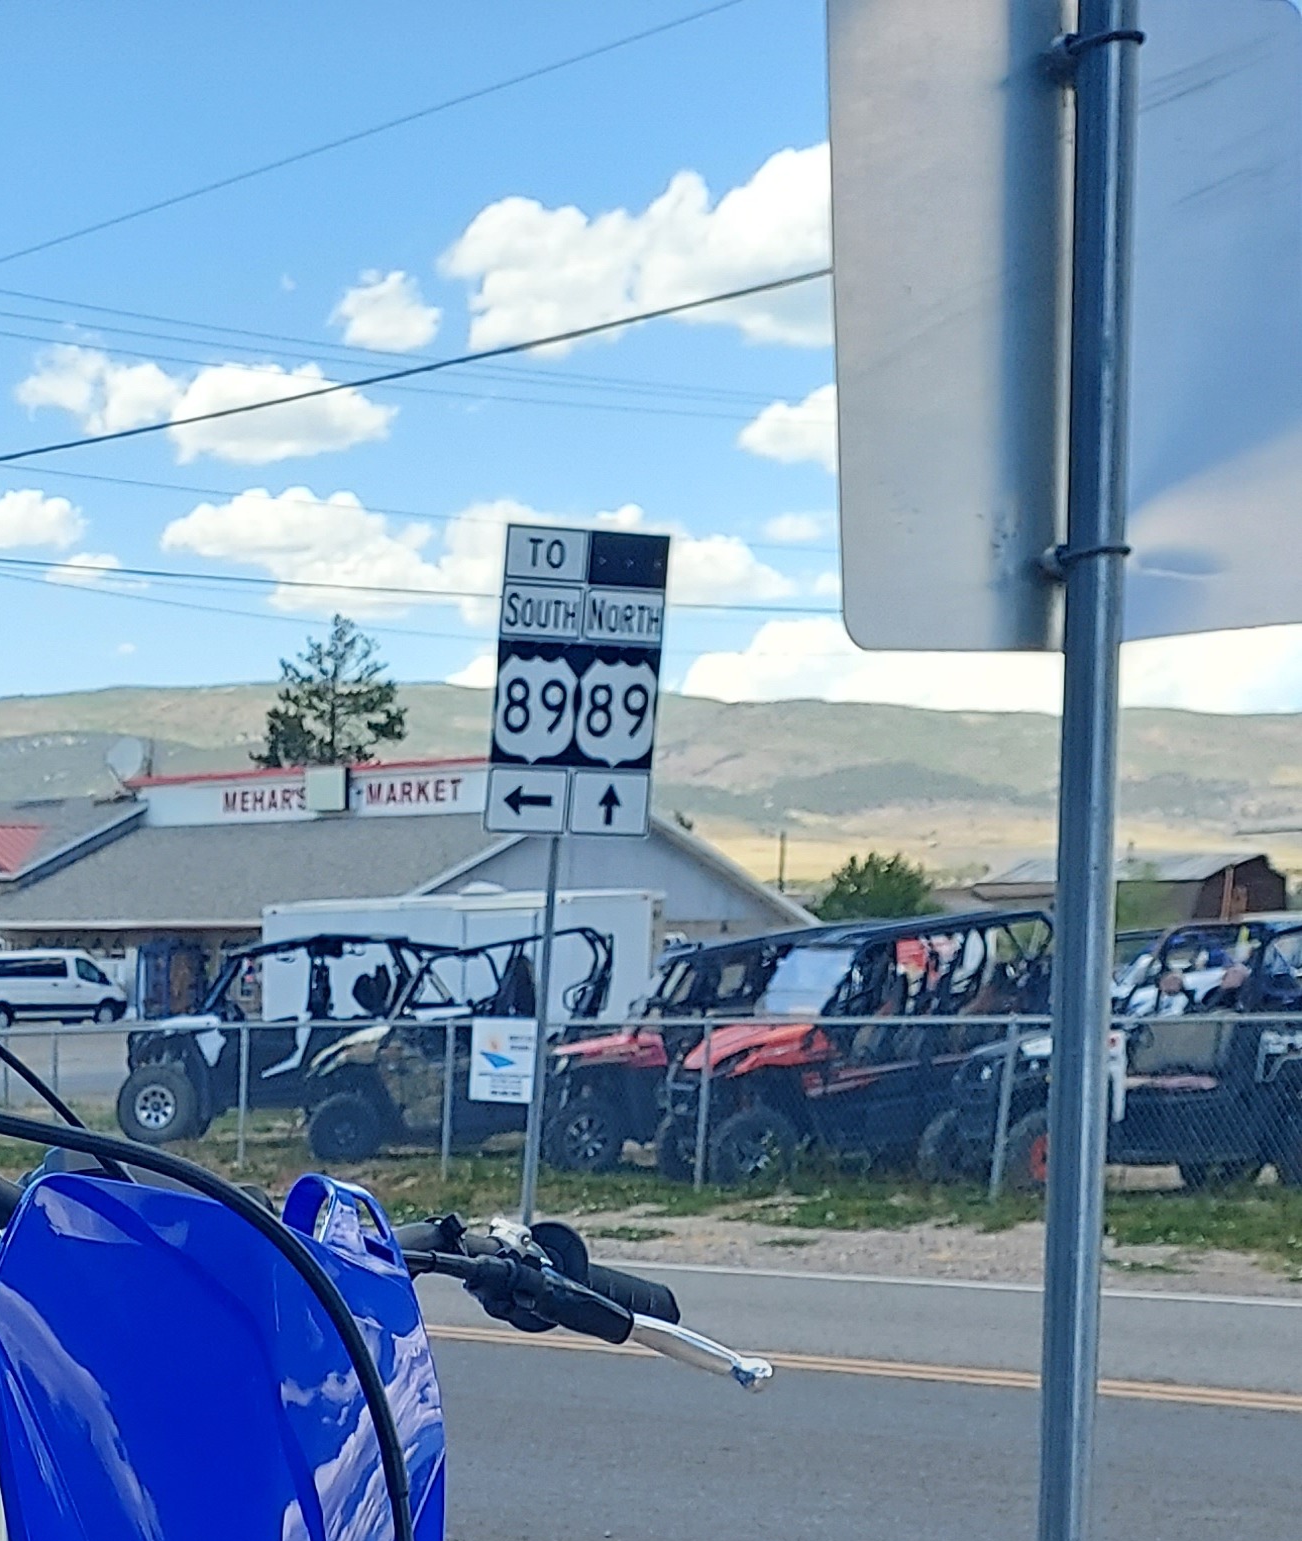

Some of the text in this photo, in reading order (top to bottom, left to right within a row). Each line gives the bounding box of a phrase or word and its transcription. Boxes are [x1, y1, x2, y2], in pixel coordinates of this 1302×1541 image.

[529, 538, 565, 569] TO
[505, 592, 577, 630] SOUTH
[588, 599, 660, 635] NORTH
[504, 677, 567, 734] 89
[587, 683, 649, 738] 89
[366, 778, 464, 806] MARKET
